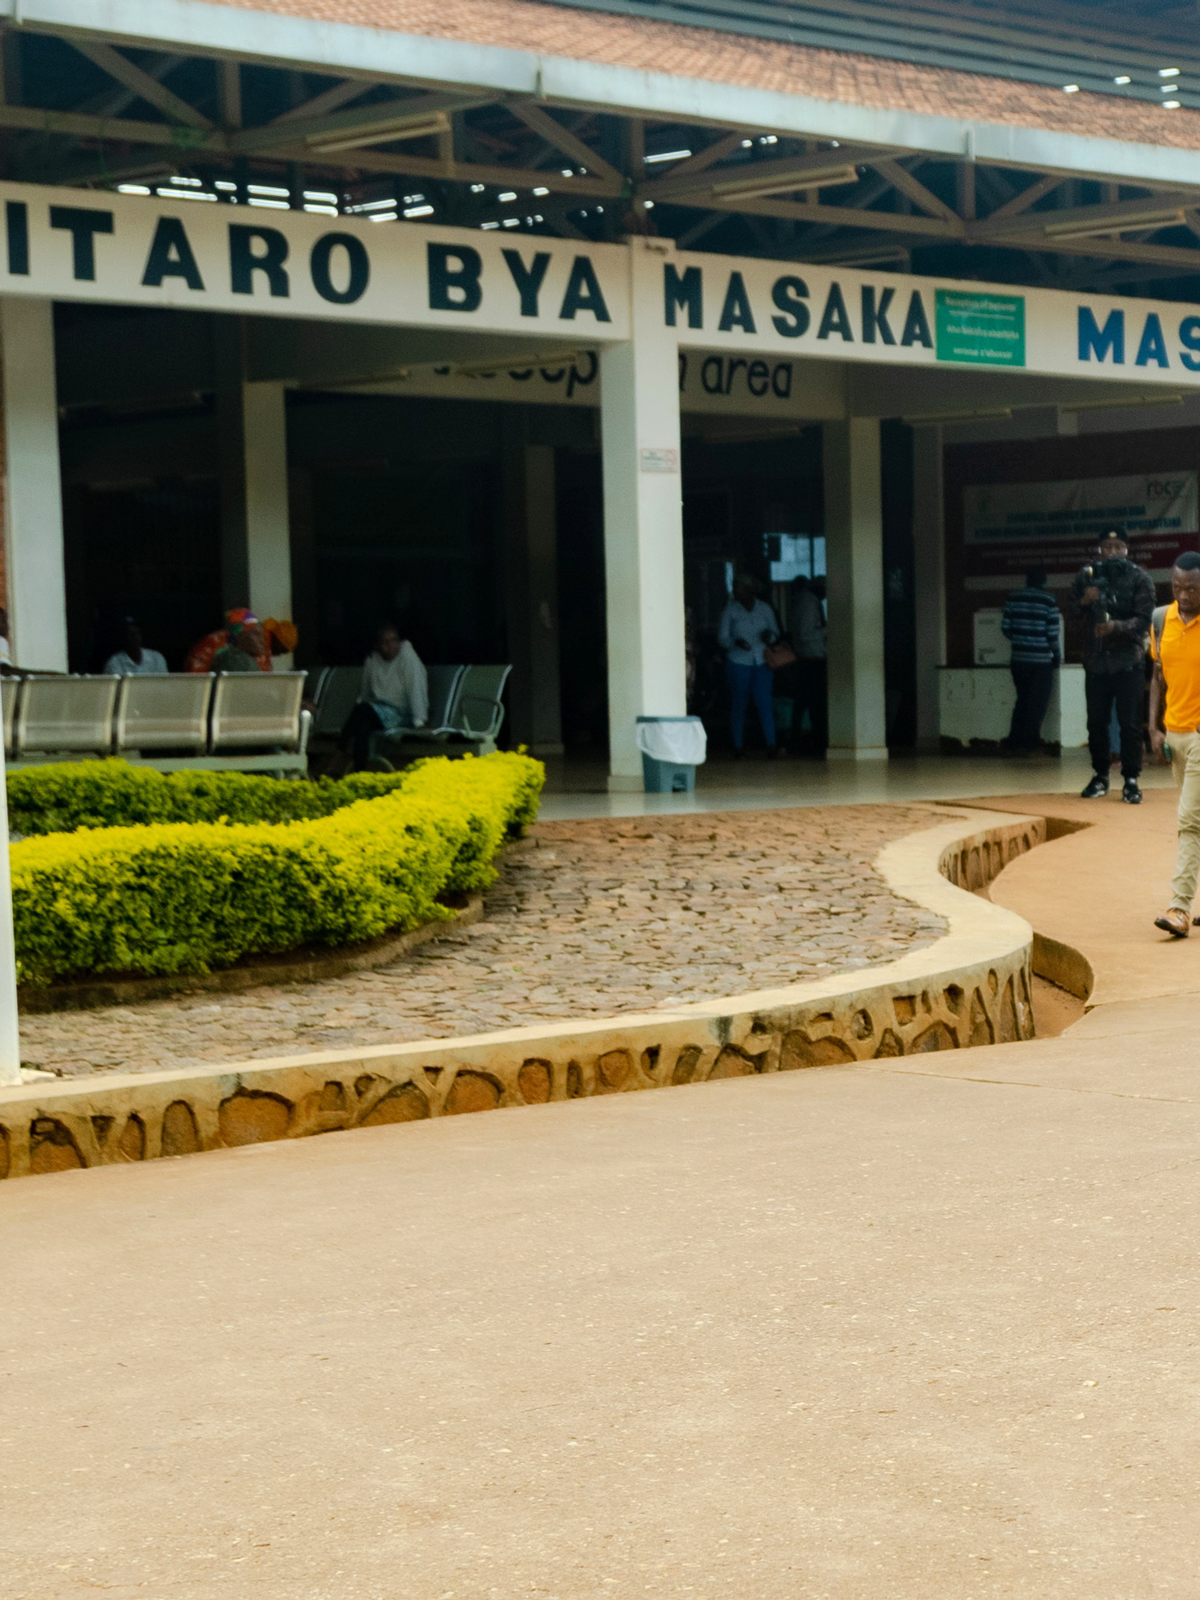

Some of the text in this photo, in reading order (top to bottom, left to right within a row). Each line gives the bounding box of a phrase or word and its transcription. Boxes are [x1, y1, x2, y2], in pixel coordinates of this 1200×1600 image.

[6, 200, 933, 349] ITARO BYA MASAKA
[701, 355, 793, 399] area
